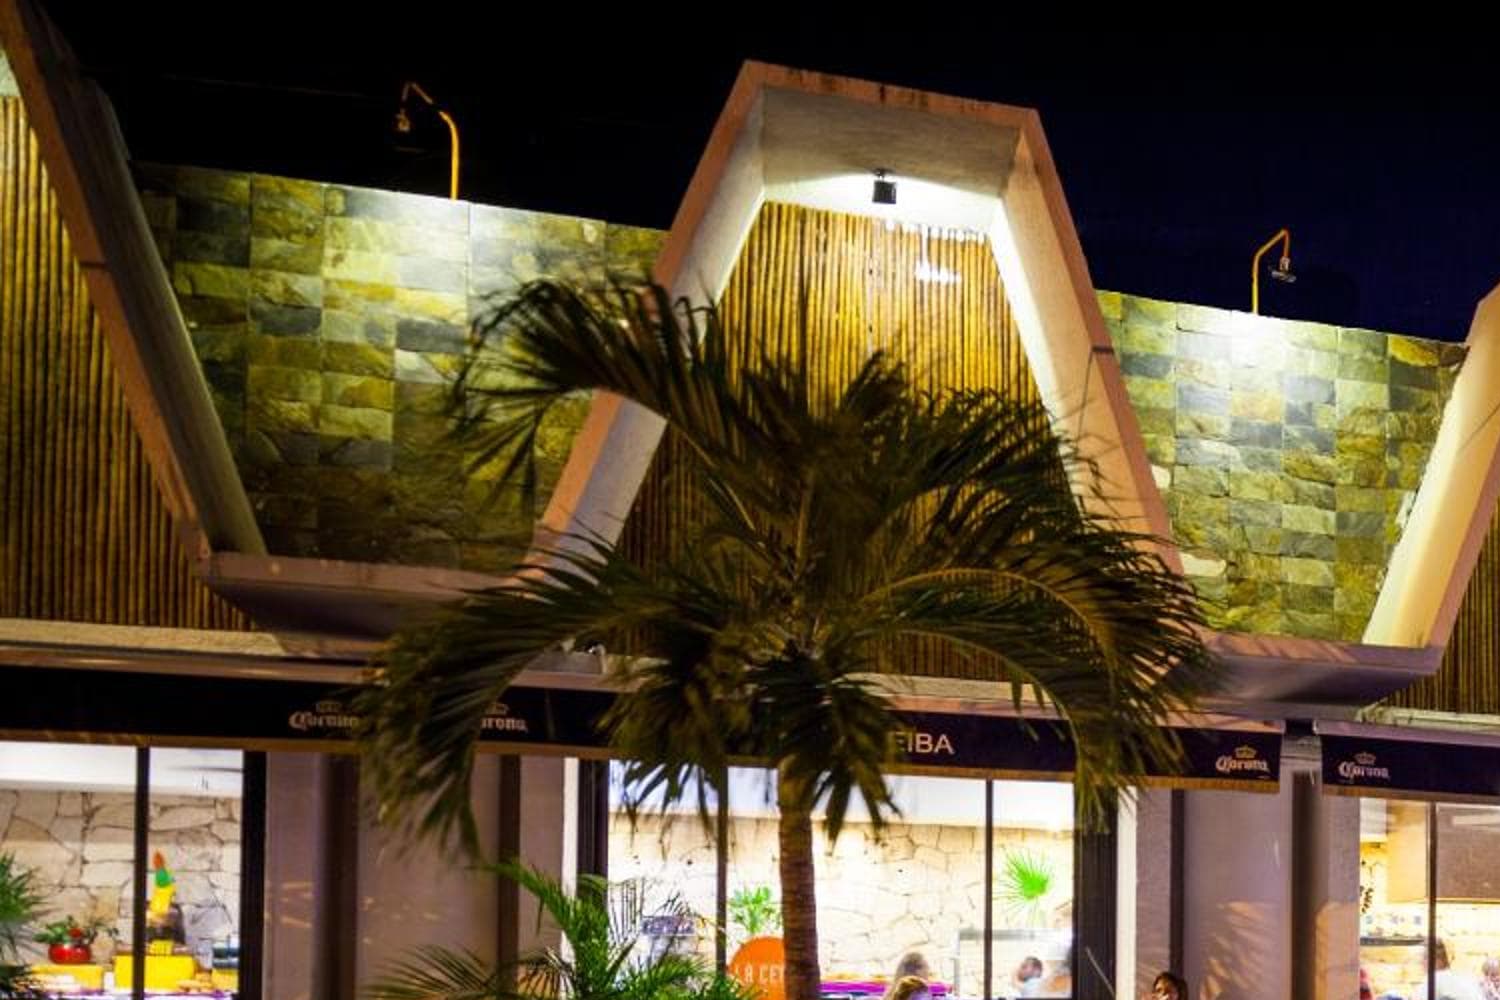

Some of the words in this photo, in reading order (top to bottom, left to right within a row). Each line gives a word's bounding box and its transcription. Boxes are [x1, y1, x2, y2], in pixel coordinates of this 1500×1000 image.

[887, 731, 956, 755] EIBA
[1216, 755, 1270, 774] Corona
[1339, 761, 1390, 780] Corona
